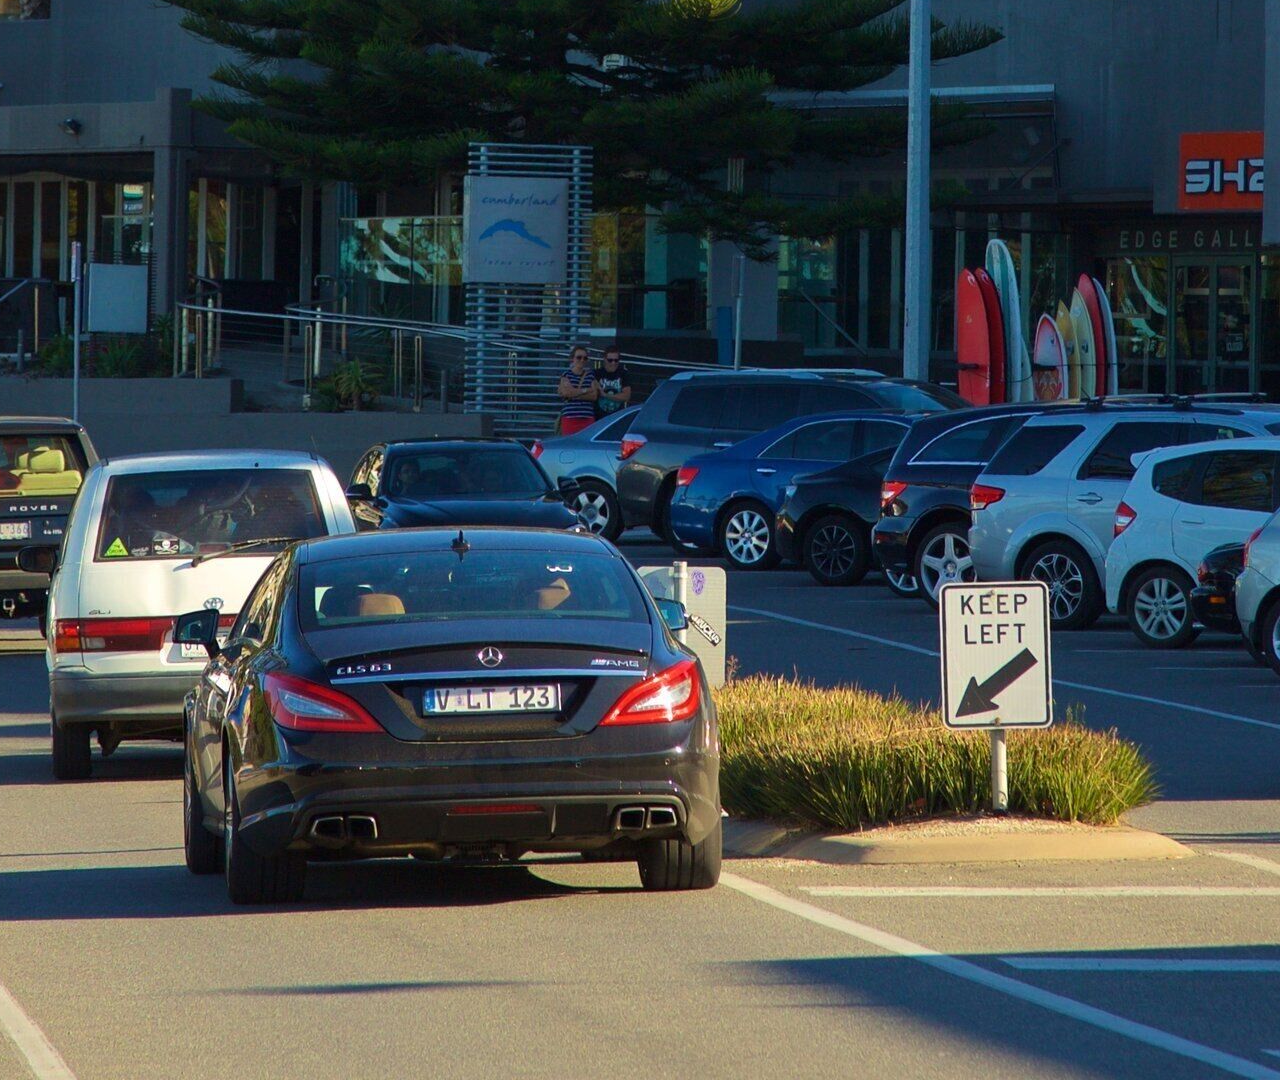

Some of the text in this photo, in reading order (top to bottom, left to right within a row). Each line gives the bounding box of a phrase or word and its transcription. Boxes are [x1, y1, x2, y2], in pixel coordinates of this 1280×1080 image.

[481, 193, 559, 206] cumberland
[1120, 230, 1178, 248] EDGE
[9, 504, 58, 513] ROVER
[960, 593, 1028, 615] KEEP
[964, 623, 1026, 645] LEFT
[336, 663, 392, 675] CLS 63
[606, 660, 639, 668] AMG
[509, 686, 550, 708] 123
